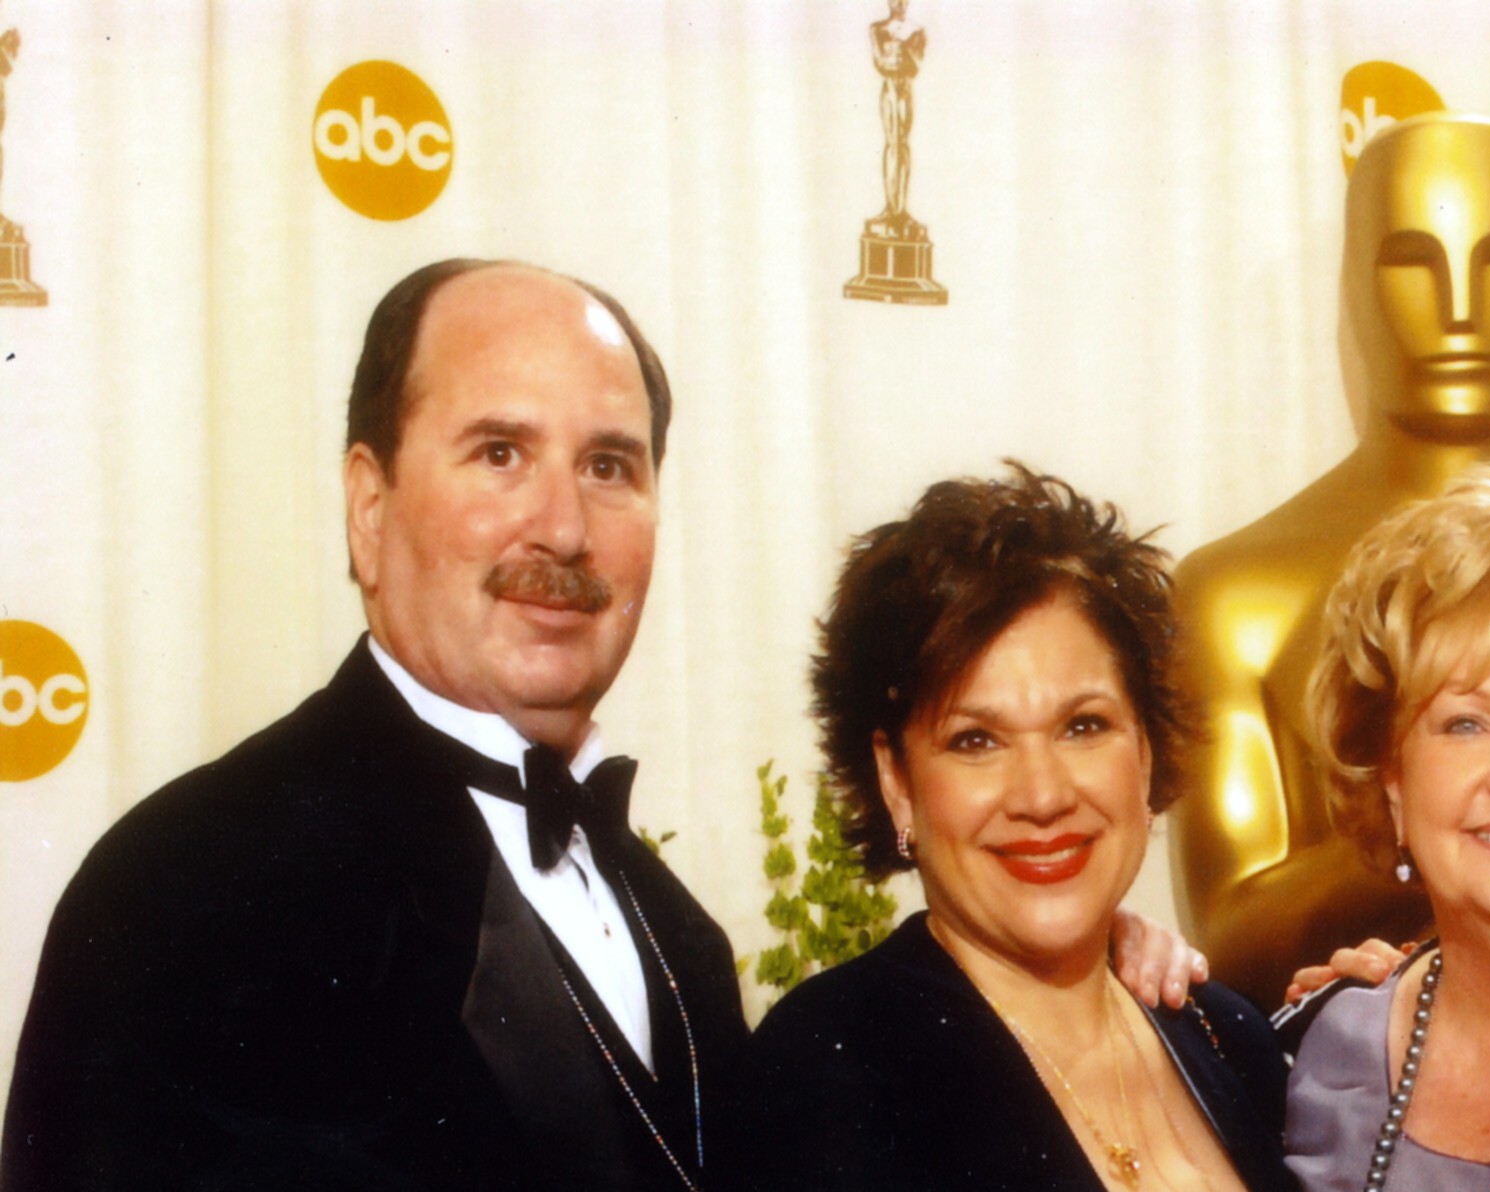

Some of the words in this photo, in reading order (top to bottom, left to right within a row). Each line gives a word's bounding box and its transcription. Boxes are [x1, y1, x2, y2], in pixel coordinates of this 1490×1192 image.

[314, 96, 451, 171] abc
[1340, 97, 1396, 159] ab
[0, 659, 86, 736] bc
